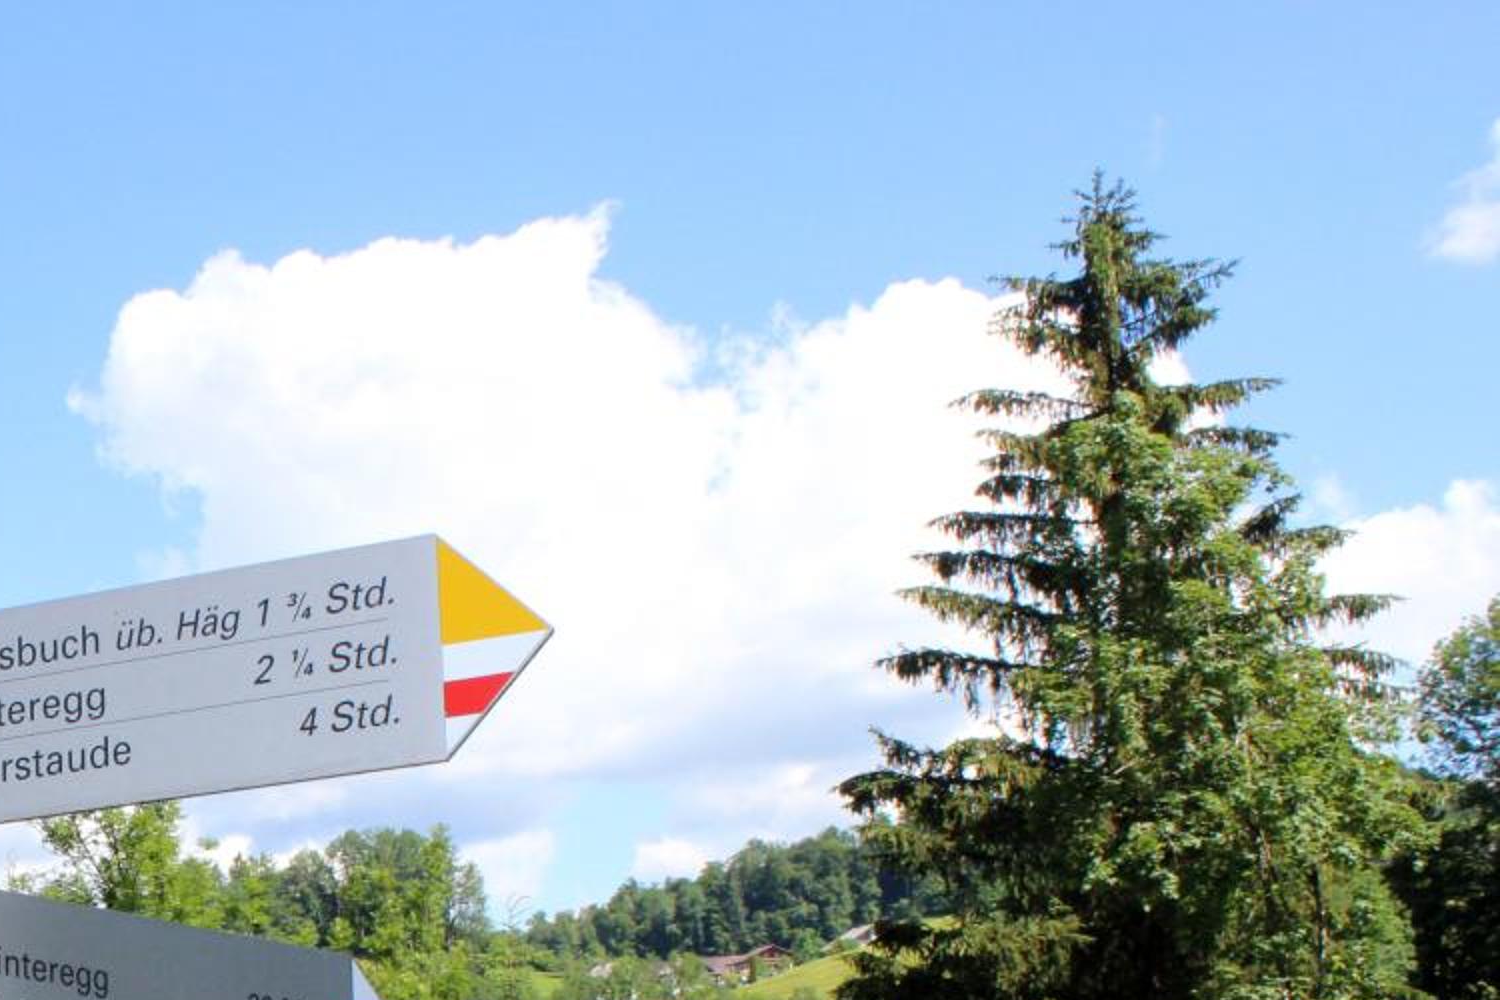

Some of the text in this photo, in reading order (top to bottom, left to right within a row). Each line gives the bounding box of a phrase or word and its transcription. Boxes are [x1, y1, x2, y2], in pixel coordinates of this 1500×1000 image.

[115, 616, 163, 651] üb.
[176, 607, 241, 642] Häg
[257, 597, 270, 628] 1
[325, 575, 395, 615] Std.
[253, 654, 275, 686] 2
[328, 634, 397, 674] Std.
[299, 706, 319, 737] 4
[330, 693, 400, 733] Std.
